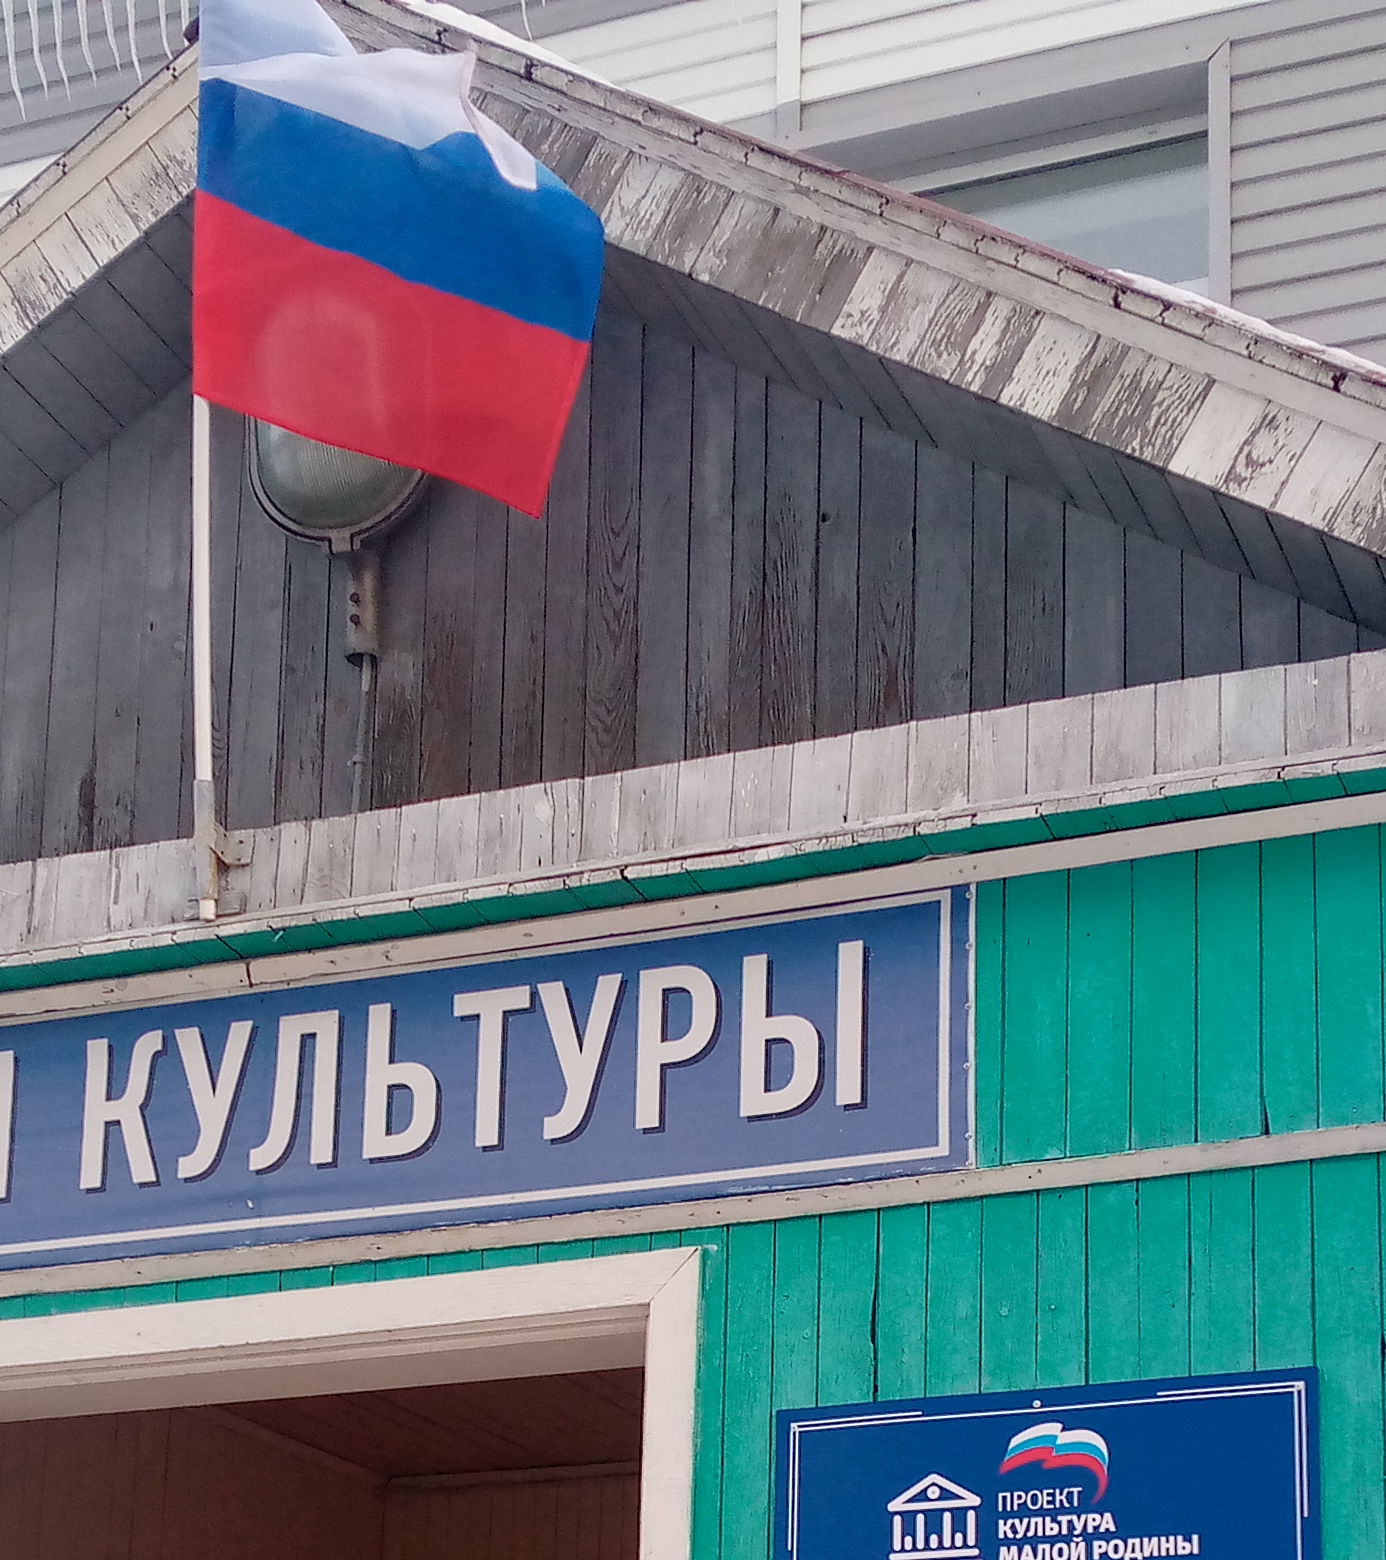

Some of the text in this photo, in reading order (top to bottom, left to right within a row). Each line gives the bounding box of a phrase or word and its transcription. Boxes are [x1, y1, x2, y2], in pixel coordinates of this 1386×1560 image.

[78, 939, 865, 1192] КУЛЬТУРЫ
[998, 1487, 1083, 1512] ПРОЕКТ
[998, 1513, 1116, 1540] КУЛЬТУРА
